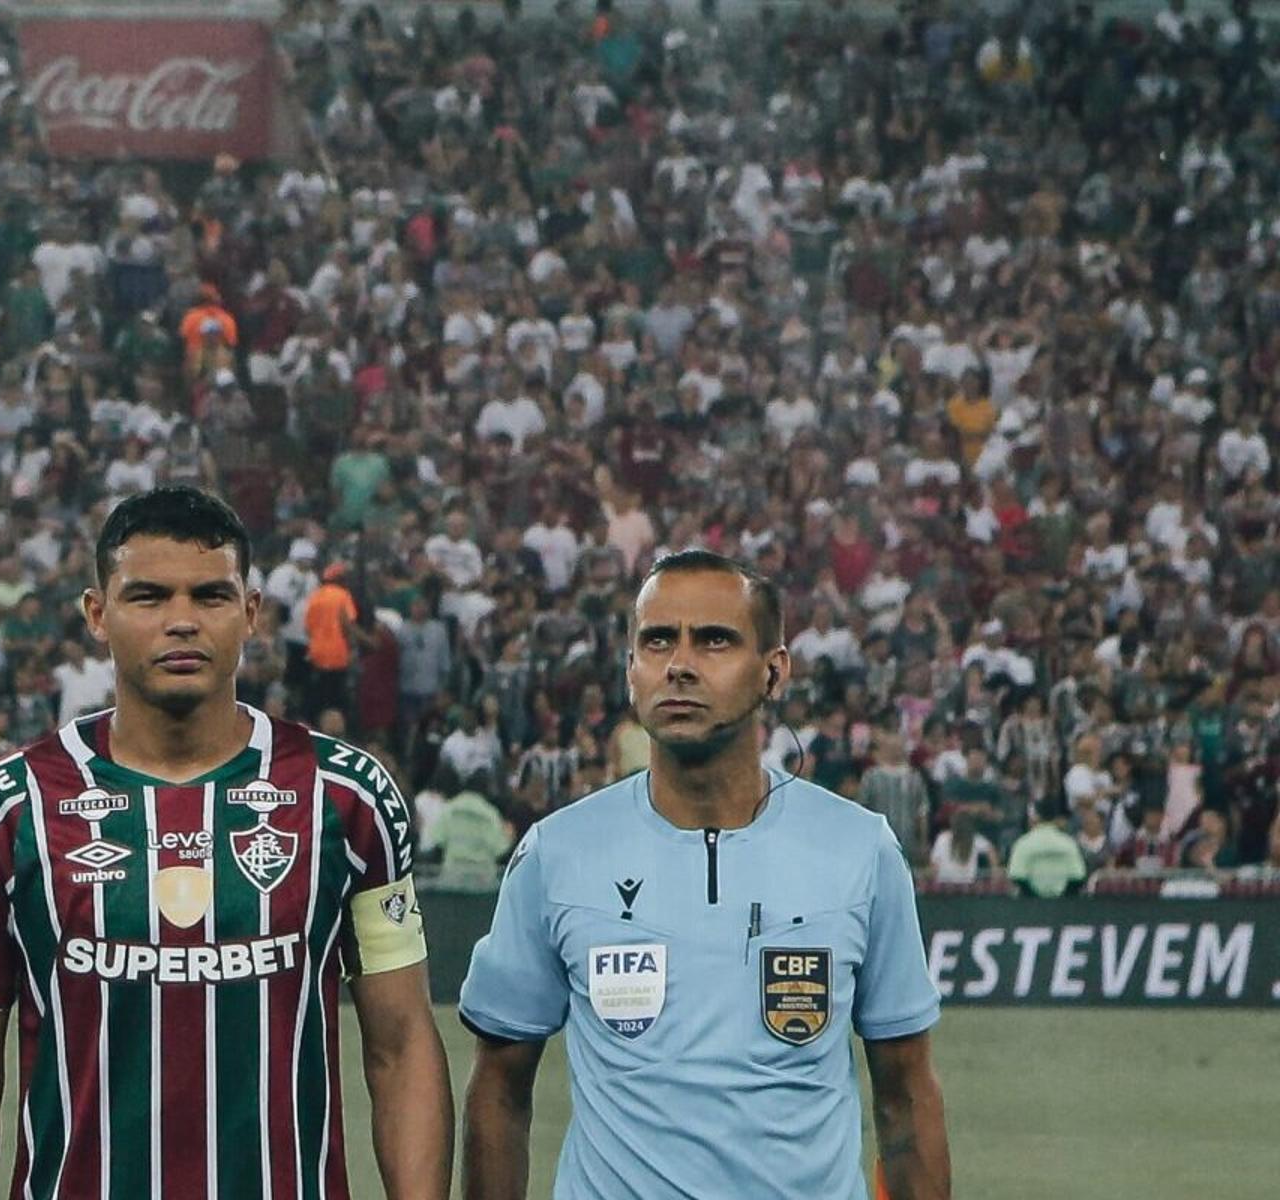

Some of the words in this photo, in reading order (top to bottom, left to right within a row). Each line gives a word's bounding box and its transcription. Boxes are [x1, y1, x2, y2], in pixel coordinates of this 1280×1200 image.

[147, 829, 213, 850] Leve
[71, 869, 126, 883] umbro
[63, 932, 301, 983] SUPERBET
[595, 952, 658, 975] FIFA
[772, 955, 819, 976] CBF
[928, 921, 1256, 998] ESTEVEM
[617, 1021, 644, 1032] 2024
